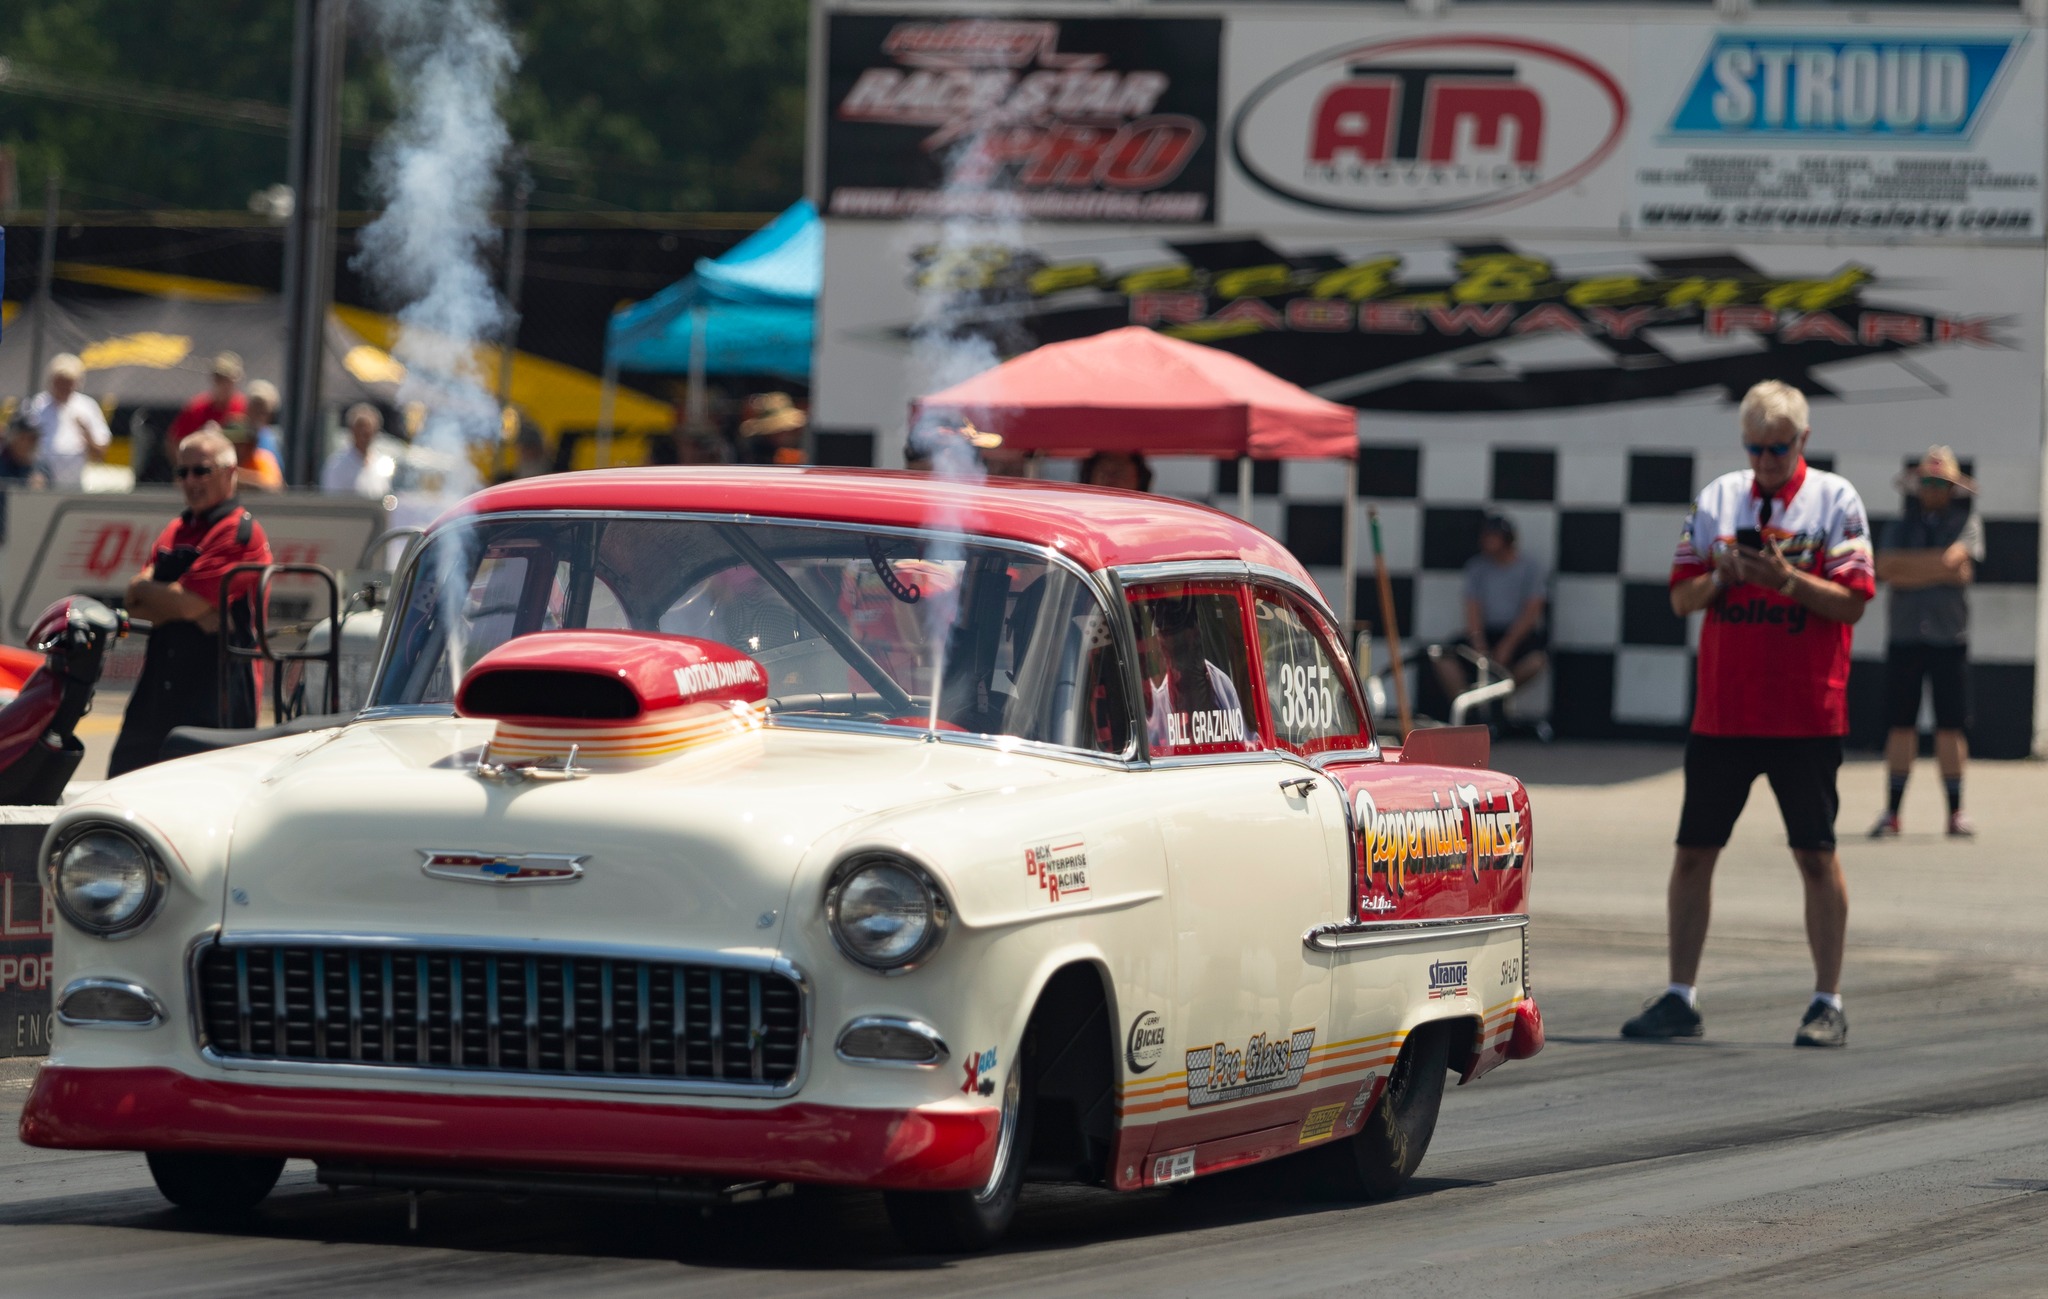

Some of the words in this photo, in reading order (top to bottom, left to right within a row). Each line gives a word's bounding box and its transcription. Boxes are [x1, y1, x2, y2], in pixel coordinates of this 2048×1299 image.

[842, 67, 1013, 113] RACE
[1003, 69, 1169, 118] STAR
[1307, 61, 1545, 166] ATM
[1711, 45, 1969, 131] STROUD
[954, 114, 1206, 191] PRO
[1129, 293, 1652, 338] RACEWAY
[1706, 305, 2008, 347] PARK
[673, 662, 720, 696] MOTION
[716, 659, 760, 687] DYNAMICS
[1281, 663, 1333, 729] 3855
[1167, 712, 1190, 746] BILL
[1192, 707, 1244, 744] GRAZIANO
[1025, 845, 1051, 876] BECK
[1355, 788, 1468, 893] Peppermint
[1456, 783, 1525, 883] Twist
[1038, 853, 1087, 889] ENTERPRISE
[1048, 871, 1086, 903] RACING
[1428, 959, 1468, 989] Strange
[1133, 1027, 1165, 1051] BICKEL
[1210, 1041, 1241, 1089] Pro
[1244, 1031, 1290, 1082] Glass
